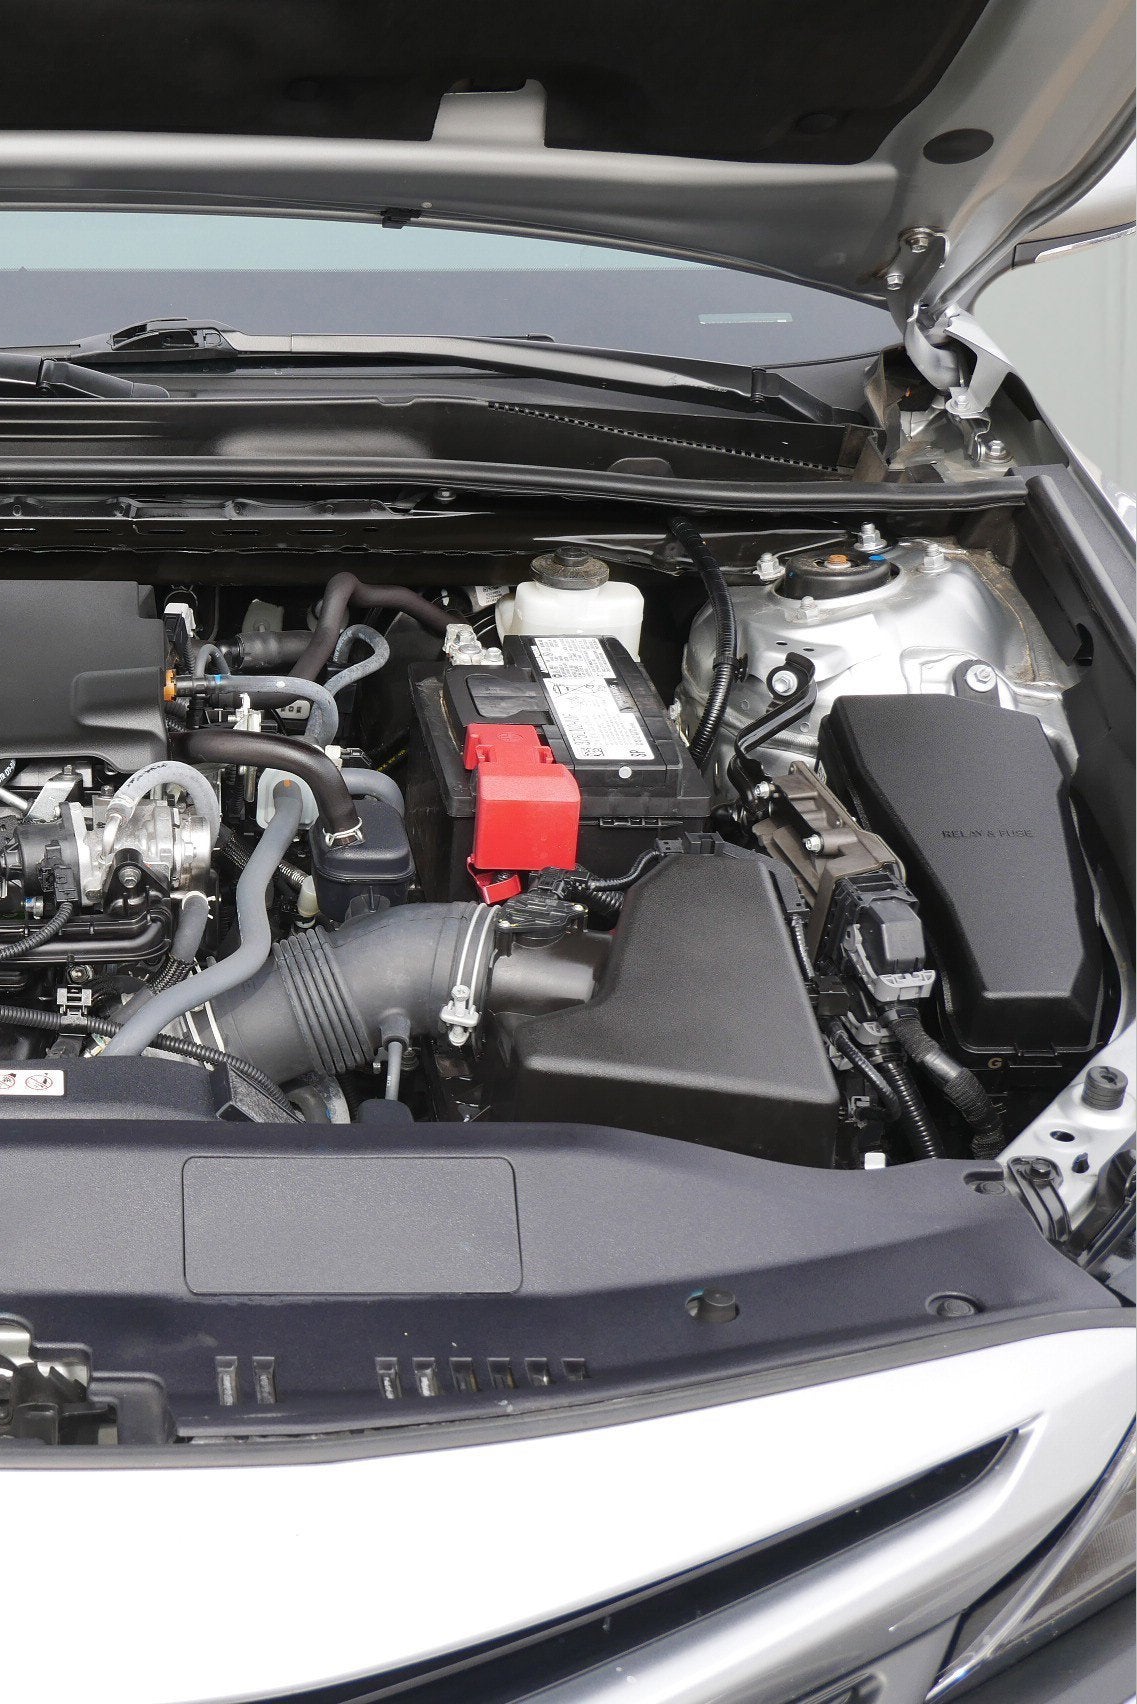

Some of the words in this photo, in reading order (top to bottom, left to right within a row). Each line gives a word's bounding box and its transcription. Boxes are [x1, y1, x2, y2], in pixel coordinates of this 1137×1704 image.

[941, 829, 982, 838] RELAY
[987, 830, 996, 838] &
[999, 829, 1033, 838] FUSE
